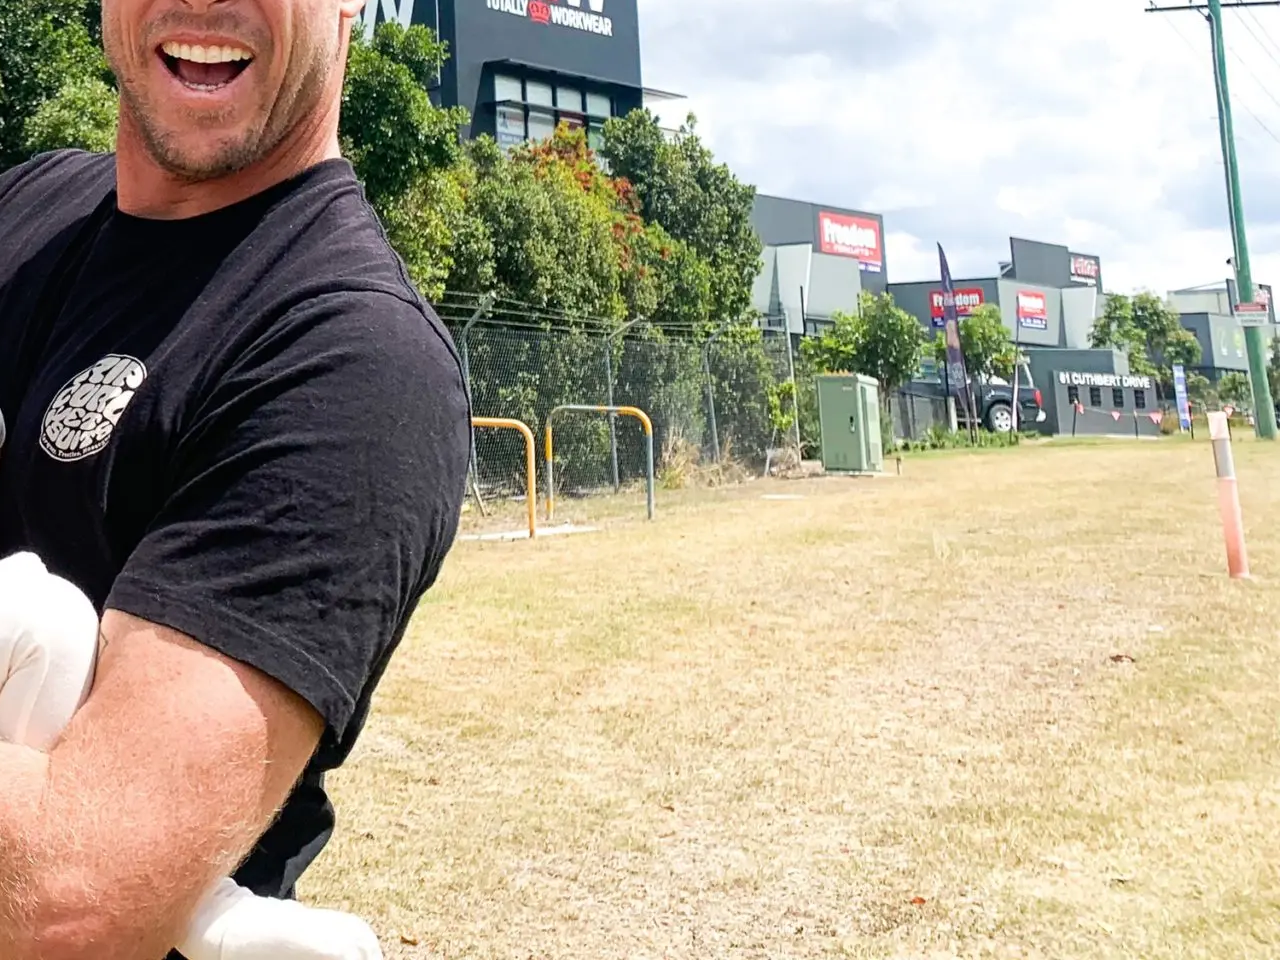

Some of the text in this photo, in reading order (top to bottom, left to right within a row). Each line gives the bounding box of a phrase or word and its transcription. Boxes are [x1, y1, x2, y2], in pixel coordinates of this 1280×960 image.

[550, 4, 613, 37] WORKWEAR
[932, 292, 980, 307] Frdom
[88, 356, 144, 389] RIP
[1071, 372, 1122, 387] CUTHBERT
[1122, 375, 1151, 388] DRIVE
